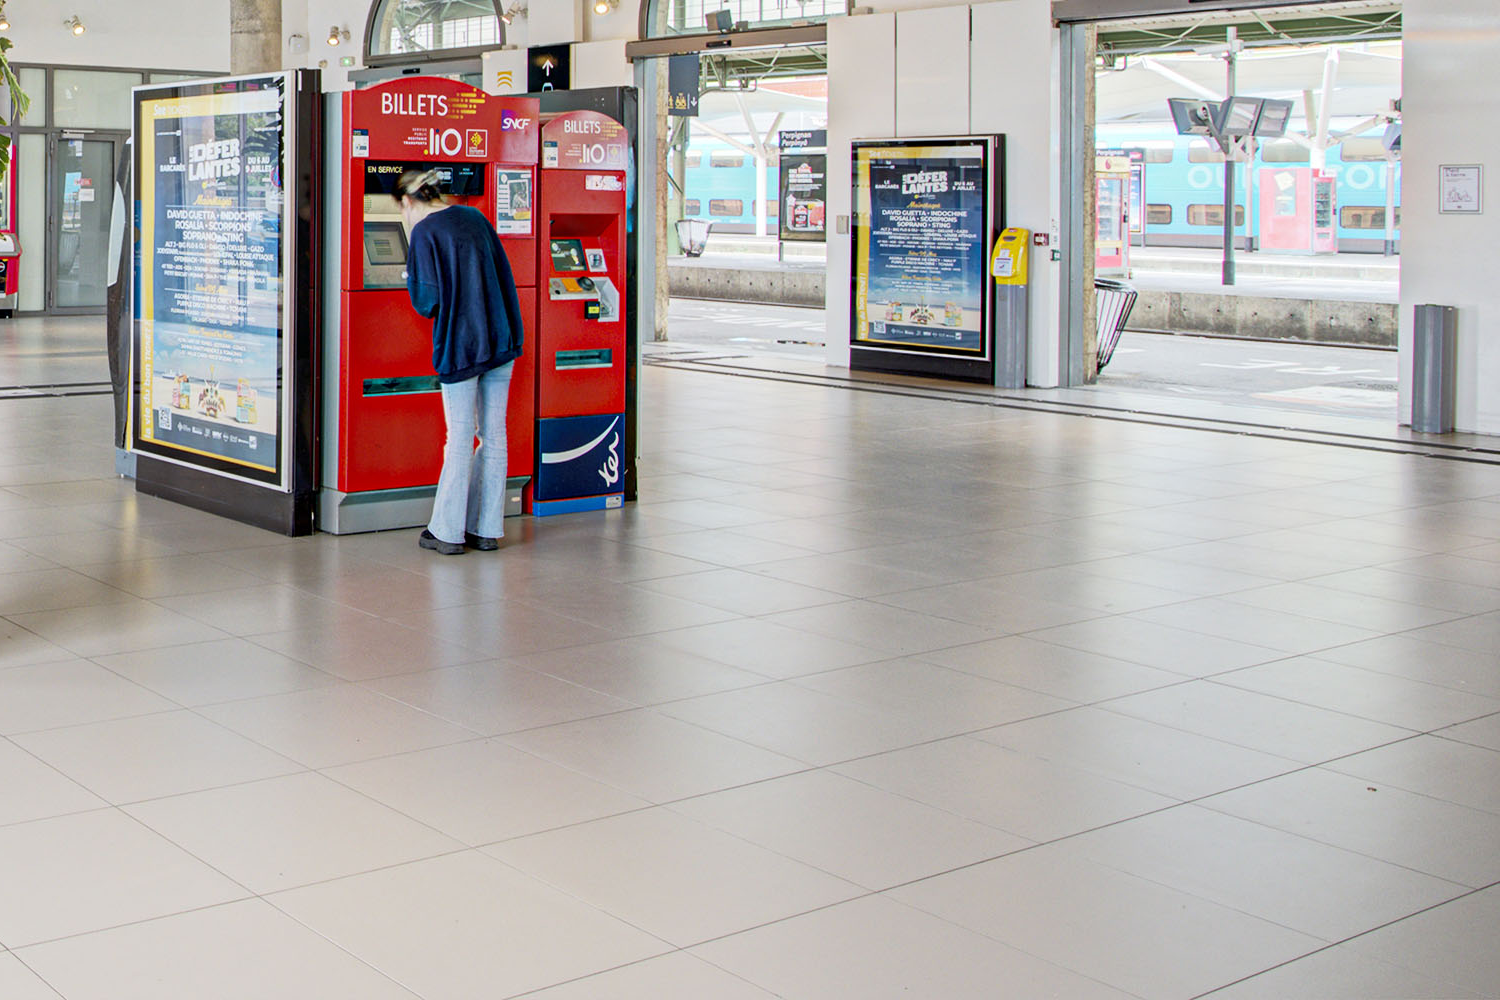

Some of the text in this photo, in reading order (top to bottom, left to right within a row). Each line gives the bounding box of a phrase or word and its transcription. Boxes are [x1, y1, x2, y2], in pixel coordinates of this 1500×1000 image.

[382, 93, 448, 116] BILLETS
[502, 118, 530, 130] SNCF
[564, 120, 600, 134] BILLETS
[194, 139, 240, 162] DÉFER
[188, 158, 240, 181] LANTES
[378, 166, 403, 174] SERVICE
[907, 171, 947, 184] DÉFER
[902, 182, 948, 194] LANTES
[167, 210, 263, 222] DAVID GUETTA INDOCHINE
[209, 221, 252, 232] SCORPIONS
[183, 231, 244, 242] SOPRANO STING
[143, 389, 151, 404] du
